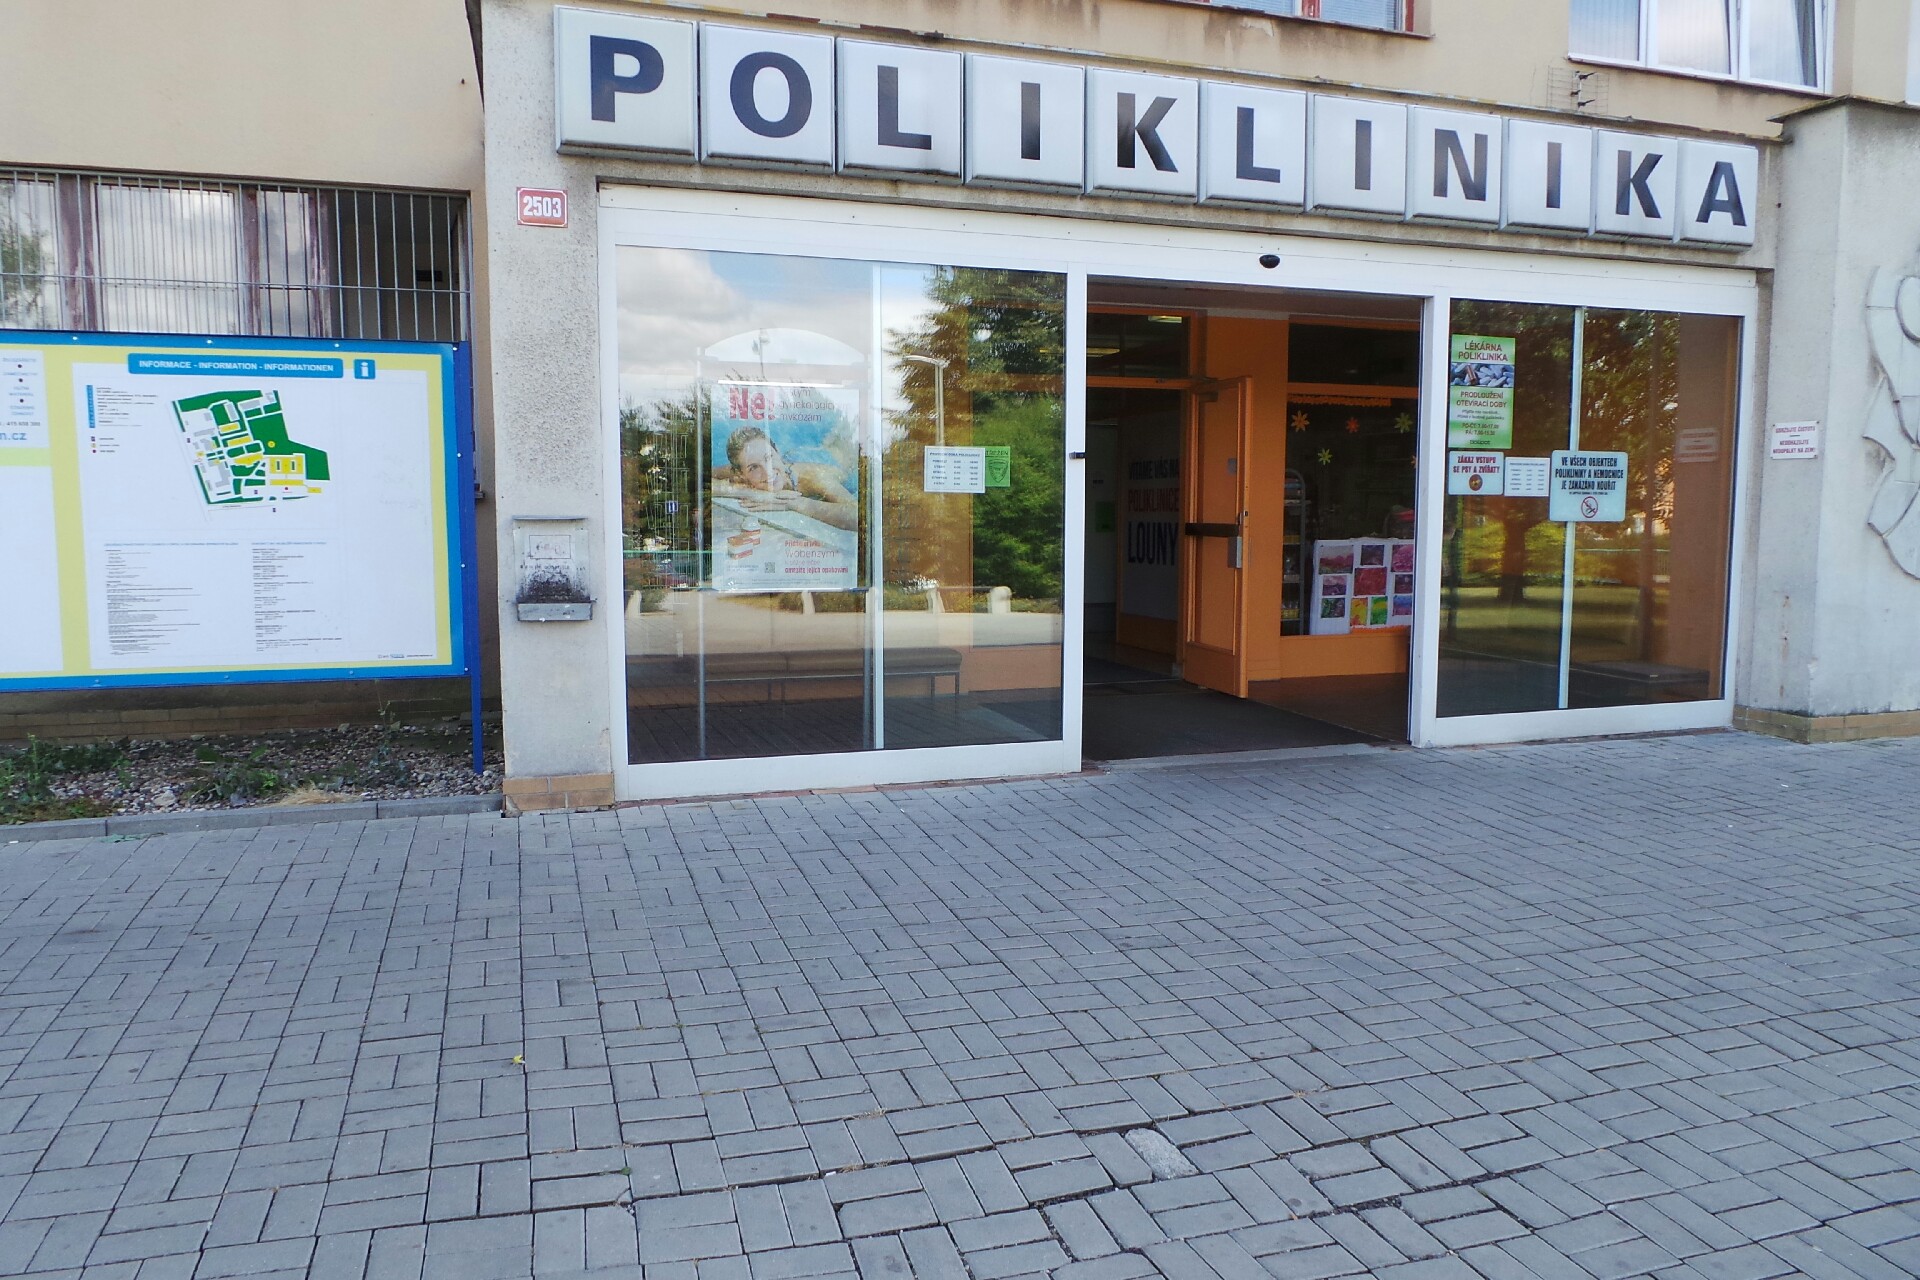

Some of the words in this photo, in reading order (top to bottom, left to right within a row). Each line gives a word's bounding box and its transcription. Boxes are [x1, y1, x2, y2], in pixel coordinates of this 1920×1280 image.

[590, 35, 1747, 227] POLIKLINIKA
[523, 195, 562, 218] 2503
[1464, 340, 1502, 351] LÉKÁRNA
[1458, 351, 1508, 361] POLIKLINIKA
[139, 360, 192, 369] INFORMACE
[199, 361, 258, 370] INFORMATION
[264, 362, 334, 372] INFORMATIONEN
[1460, 390, 1504, 399] PRODLOUŽENÍ
[730, 387, 776, 421] Ne!
[1456, 399, 1489, 407] OTEVÍRACÍ
[1457, 455, 1474, 463] ZÁKAZ
[1561, 457, 1568, 466] VE
[1570, 455, 1586, 466] VŠECH
[1588, 457, 1618, 467] OBJEKTECH
[1453, 465, 1460, 473] SE
[1479, 464, 1500, 473] ZVÍŘATY
[1555, 468, 1587, 478] POLIKLINIKY
[1587, 469, 1592, 478] A
[1593, 469, 1624, 479] NEMOCNICE
[1561, 480, 1567, 490] JE
[1568, 479, 1595, 490] ZAKÁZÁNO
[1596, 480, 1616, 490] KOUŘIT
[1128, 487, 1180, 513] POLIKLINICE
[1128, 520, 1180, 566] LOUNY
